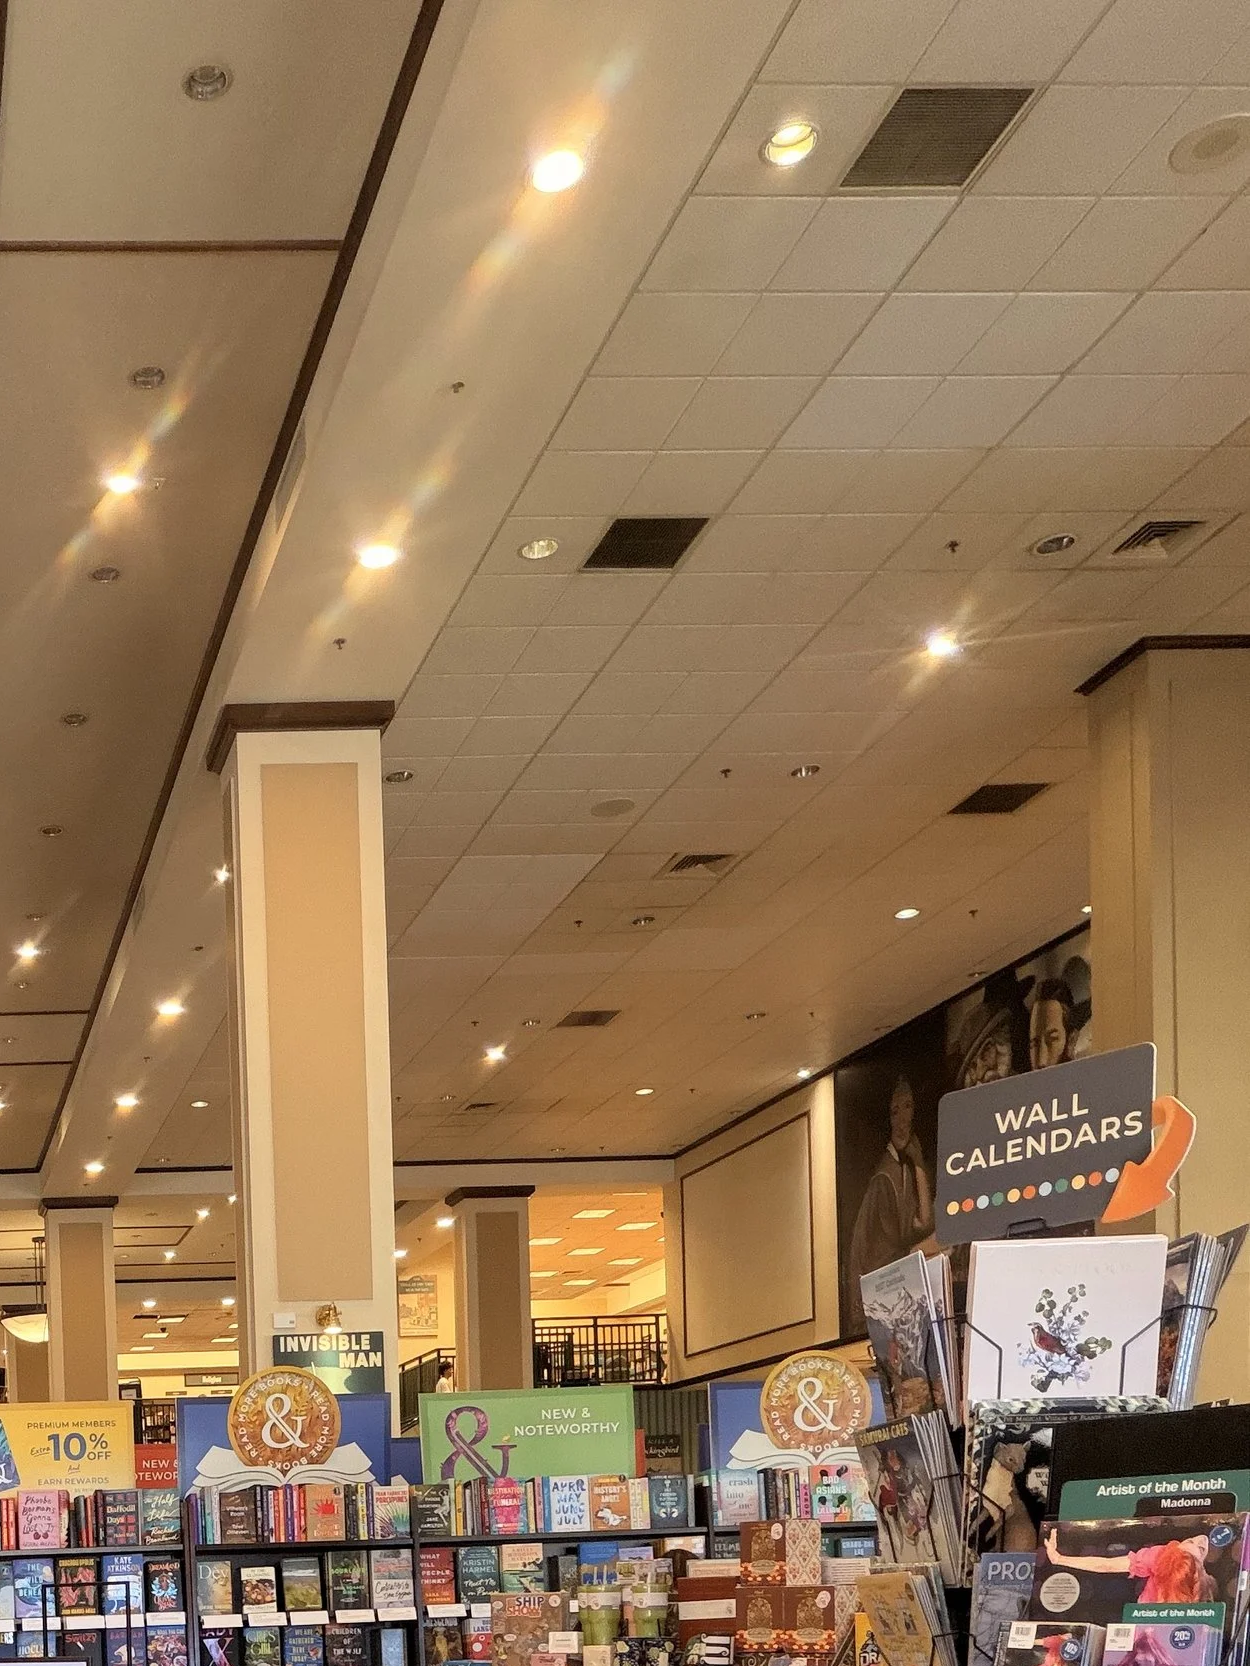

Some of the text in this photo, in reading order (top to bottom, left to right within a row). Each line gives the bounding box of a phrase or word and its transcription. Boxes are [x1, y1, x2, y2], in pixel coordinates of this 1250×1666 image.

[995, 1093, 1089, 1134] WALL
[945, 1111, 1143, 1176] CALENDARS
[279, 1335, 370, 1353] INVISIBLE
[339, 1352, 382, 1368] MAN
[791, 1359, 831, 1375] BOOKS
[259, 1376, 300, 1391] BOOKS
[842, 1373, 861, 1404] READ
[770, 1376, 789, 1407] MORE
[237, 1386, 259, 1422] MORE
[309, 1390, 330, 1422] READ
[541, 1406, 591, 1422] NEW &
[27, 1420, 116, 1429] PREMIUM MEMBERS
[514, 1419, 620, 1440] NOTEWORTHY
[770, 1411, 792, 1442] READ
[841, 1409, 860, 1441] MORE
[891, 1423, 909, 1438] CATS
[238, 1426, 257, 1459] READ
[310, 1425, 330, 1459] MORE
[799, 1439, 840, 1453] BOOKS
[30, 1446, 50, 1457] Extra
[87, 1451, 112, 1461] OFF
[142, 1459, 169, 1469] NEW
[267, 1457, 309, 1471] BOOKS
[37, 1476, 110, 1486] EARN REWARDS
[728, 1478, 753, 1488] crash
[822, 1476, 840, 1486] BAD
[816, 1485, 847, 1495] ASIANS
[1097, 1477, 1226, 1497] Artist of the Month
[557, 1493, 582, 1504] MAY
[726, 1491, 745, 1500] into
[555, 1503, 585, 1514] JUNE
[1161, 1497, 1211, 1509] Madonna
[106, 1505, 136, 1514] Daffodil
[557, 1515, 584, 1526] JULY
[114, 1556, 132, 1565] KATE
[463, 1558, 495, 1567] KRISTIN
[27, 1563, 41, 1572] THE
[107, 1564, 141, 1573] ATKINSON
[422, 1569, 451, 1577] PEOPLE
[462, 1566, 497, 1574] HARMEL
[516, 1596, 544, 1607] SHIP
[1132, 1608, 1215, 1618] Artist of the Month
[331, 1627, 362, 1636] CHILDREN
